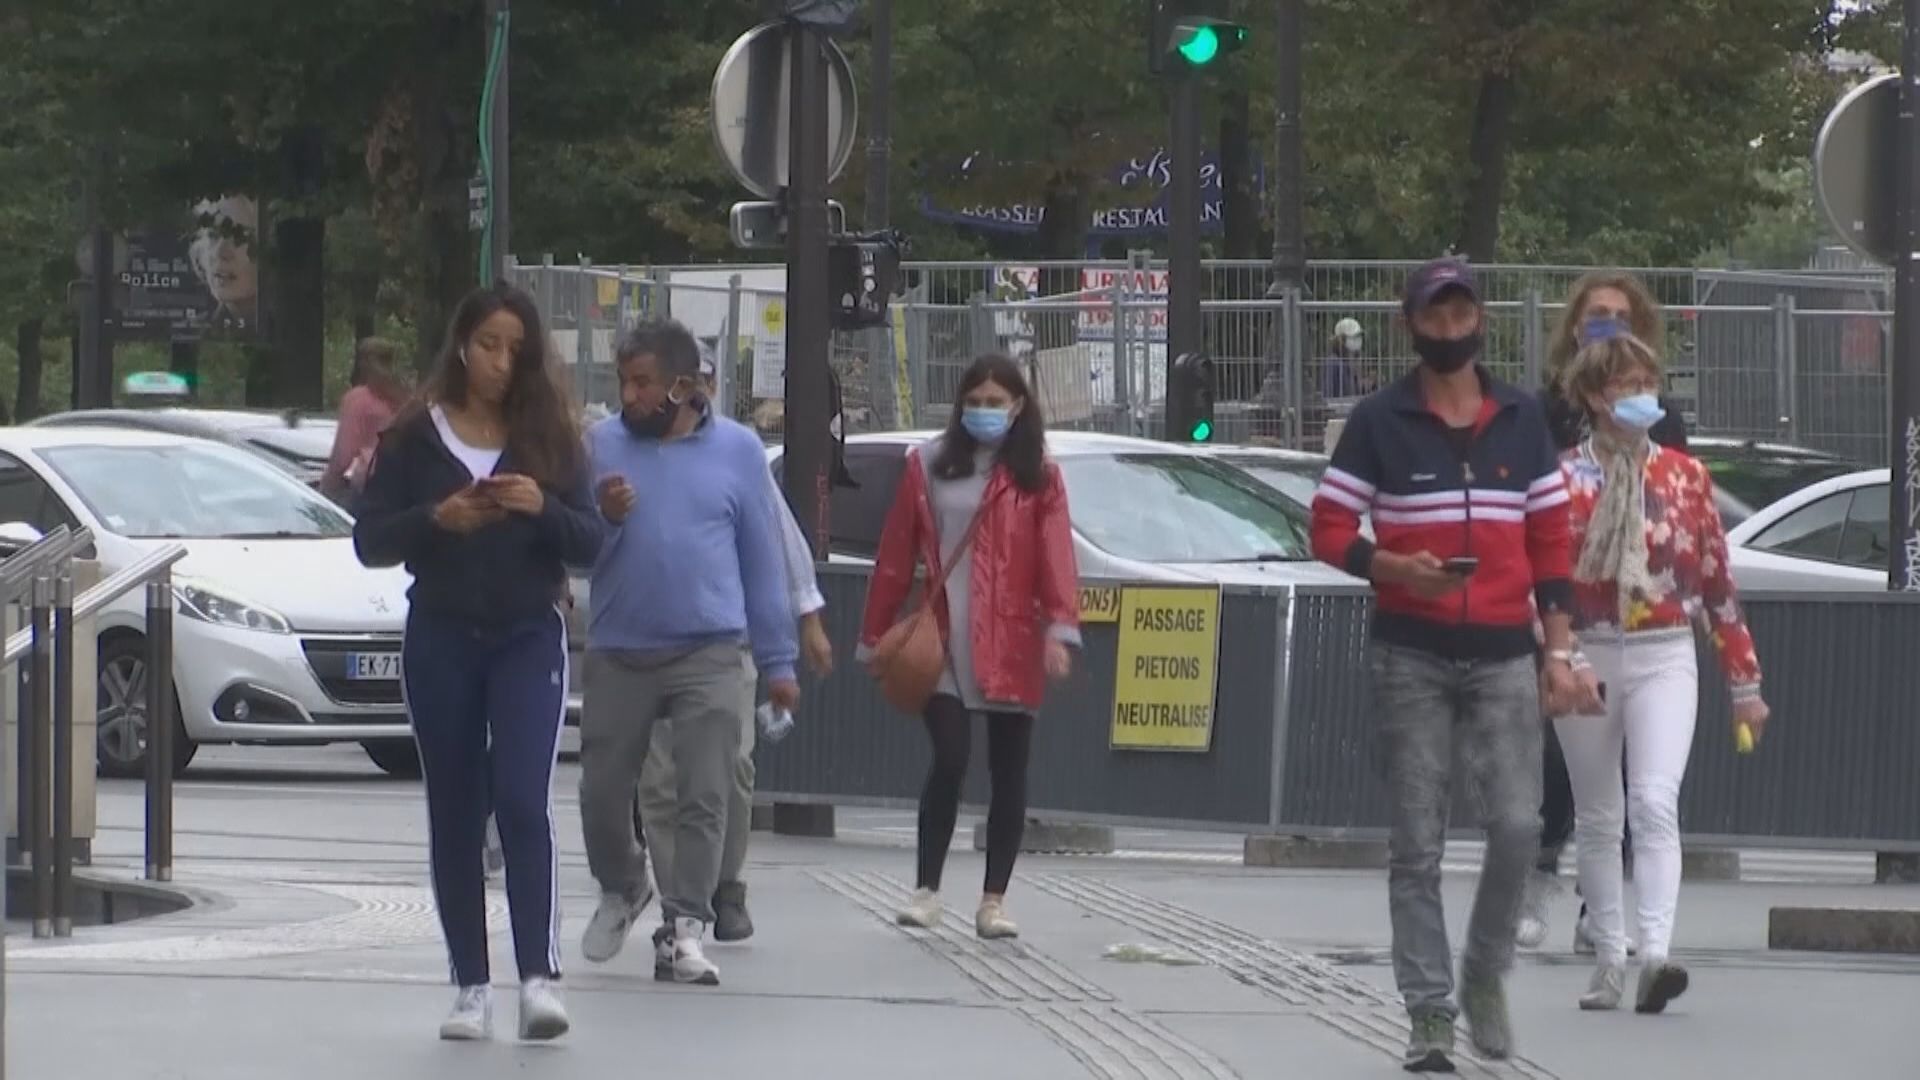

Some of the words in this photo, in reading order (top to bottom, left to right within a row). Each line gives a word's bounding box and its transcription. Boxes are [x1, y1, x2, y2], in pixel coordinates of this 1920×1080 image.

[1134, 608, 1205, 632] PASSAGE
[1134, 655, 1200, 680] PIETONS
[1116, 703, 1209, 728] NEUTRALISE
